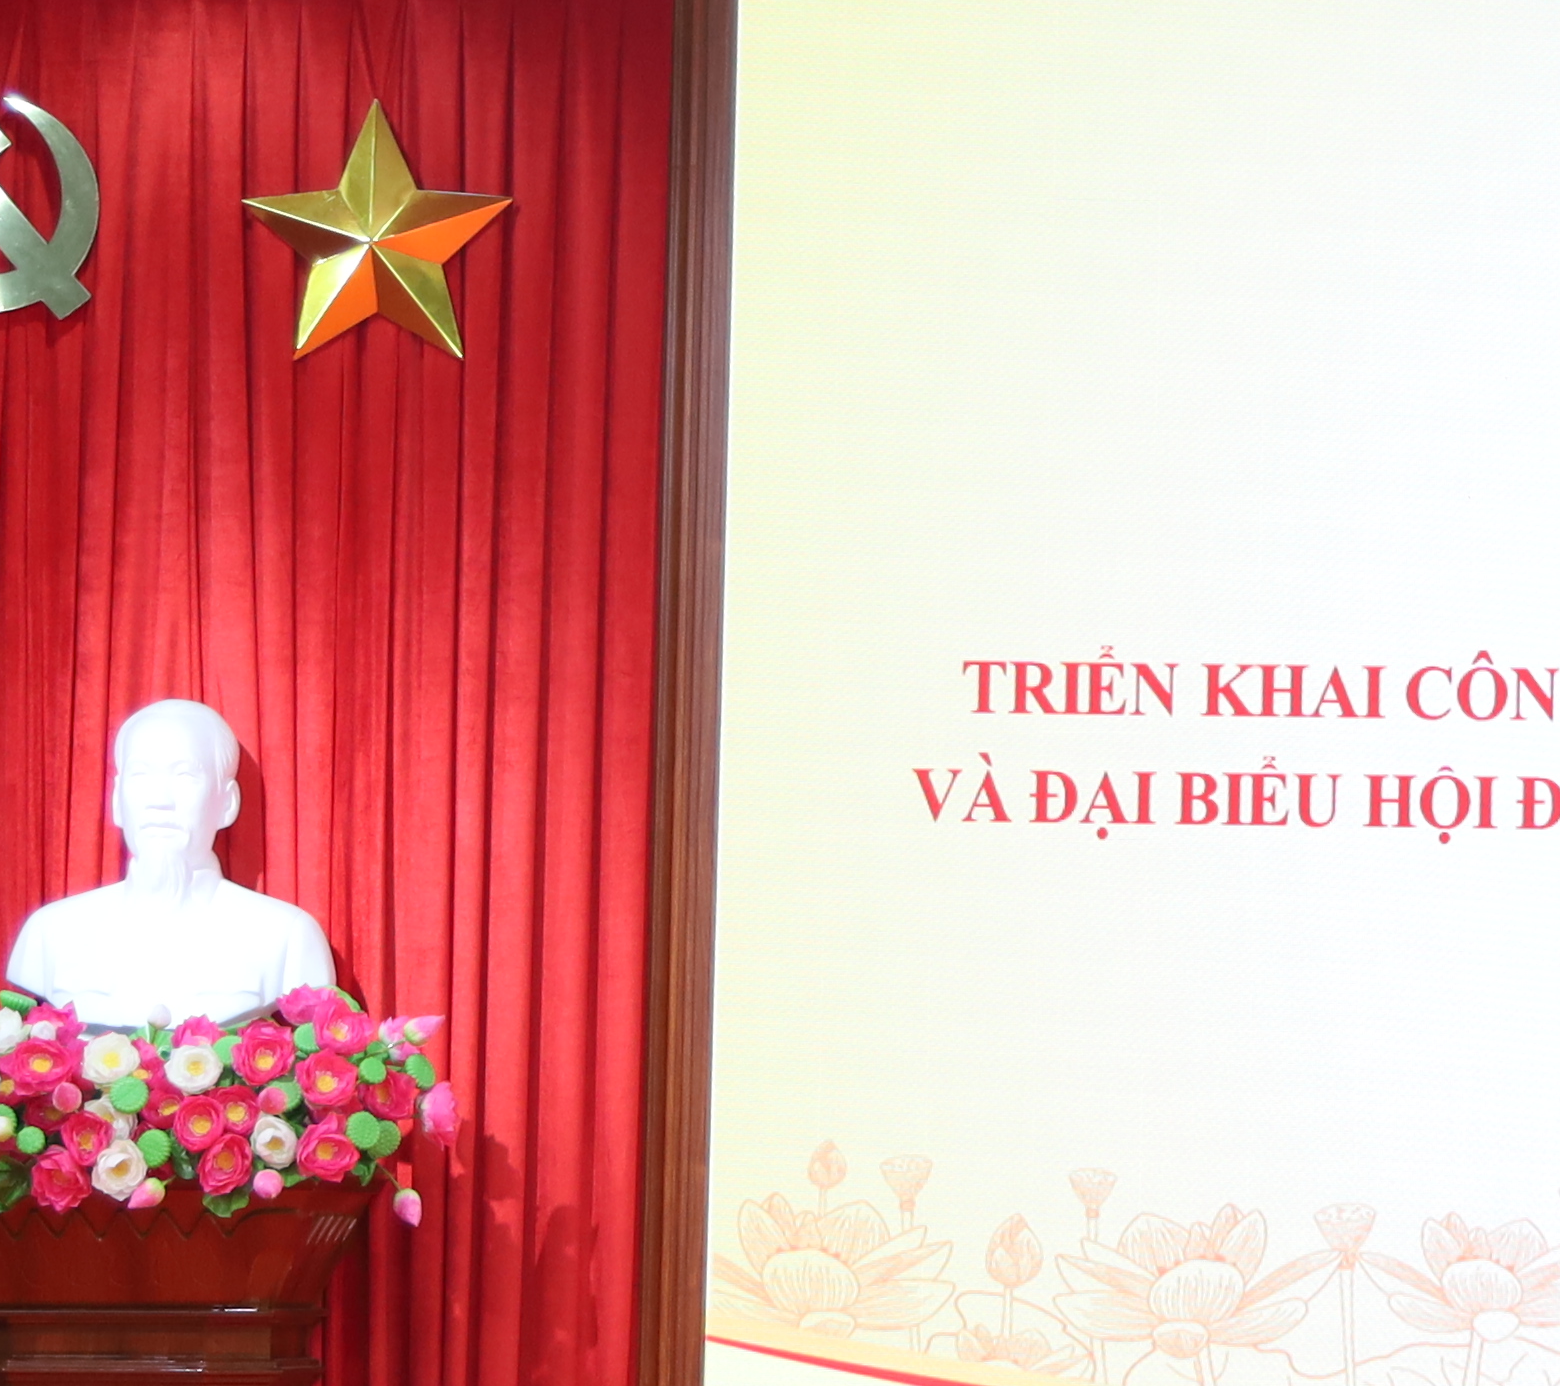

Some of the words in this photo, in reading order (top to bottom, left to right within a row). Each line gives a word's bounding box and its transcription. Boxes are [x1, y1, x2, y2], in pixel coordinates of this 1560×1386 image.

[963, 646, 1178, 715] TRIỂN
[1203, 664, 1384, 718] KHAI
[913, 752, 1011, 822] VÀ
[1030, 770, 1156, 839] ĐẠI
[1176, 756, 1342, 828] BIỂU
[1364, 766, 1496, 844] HỘI
